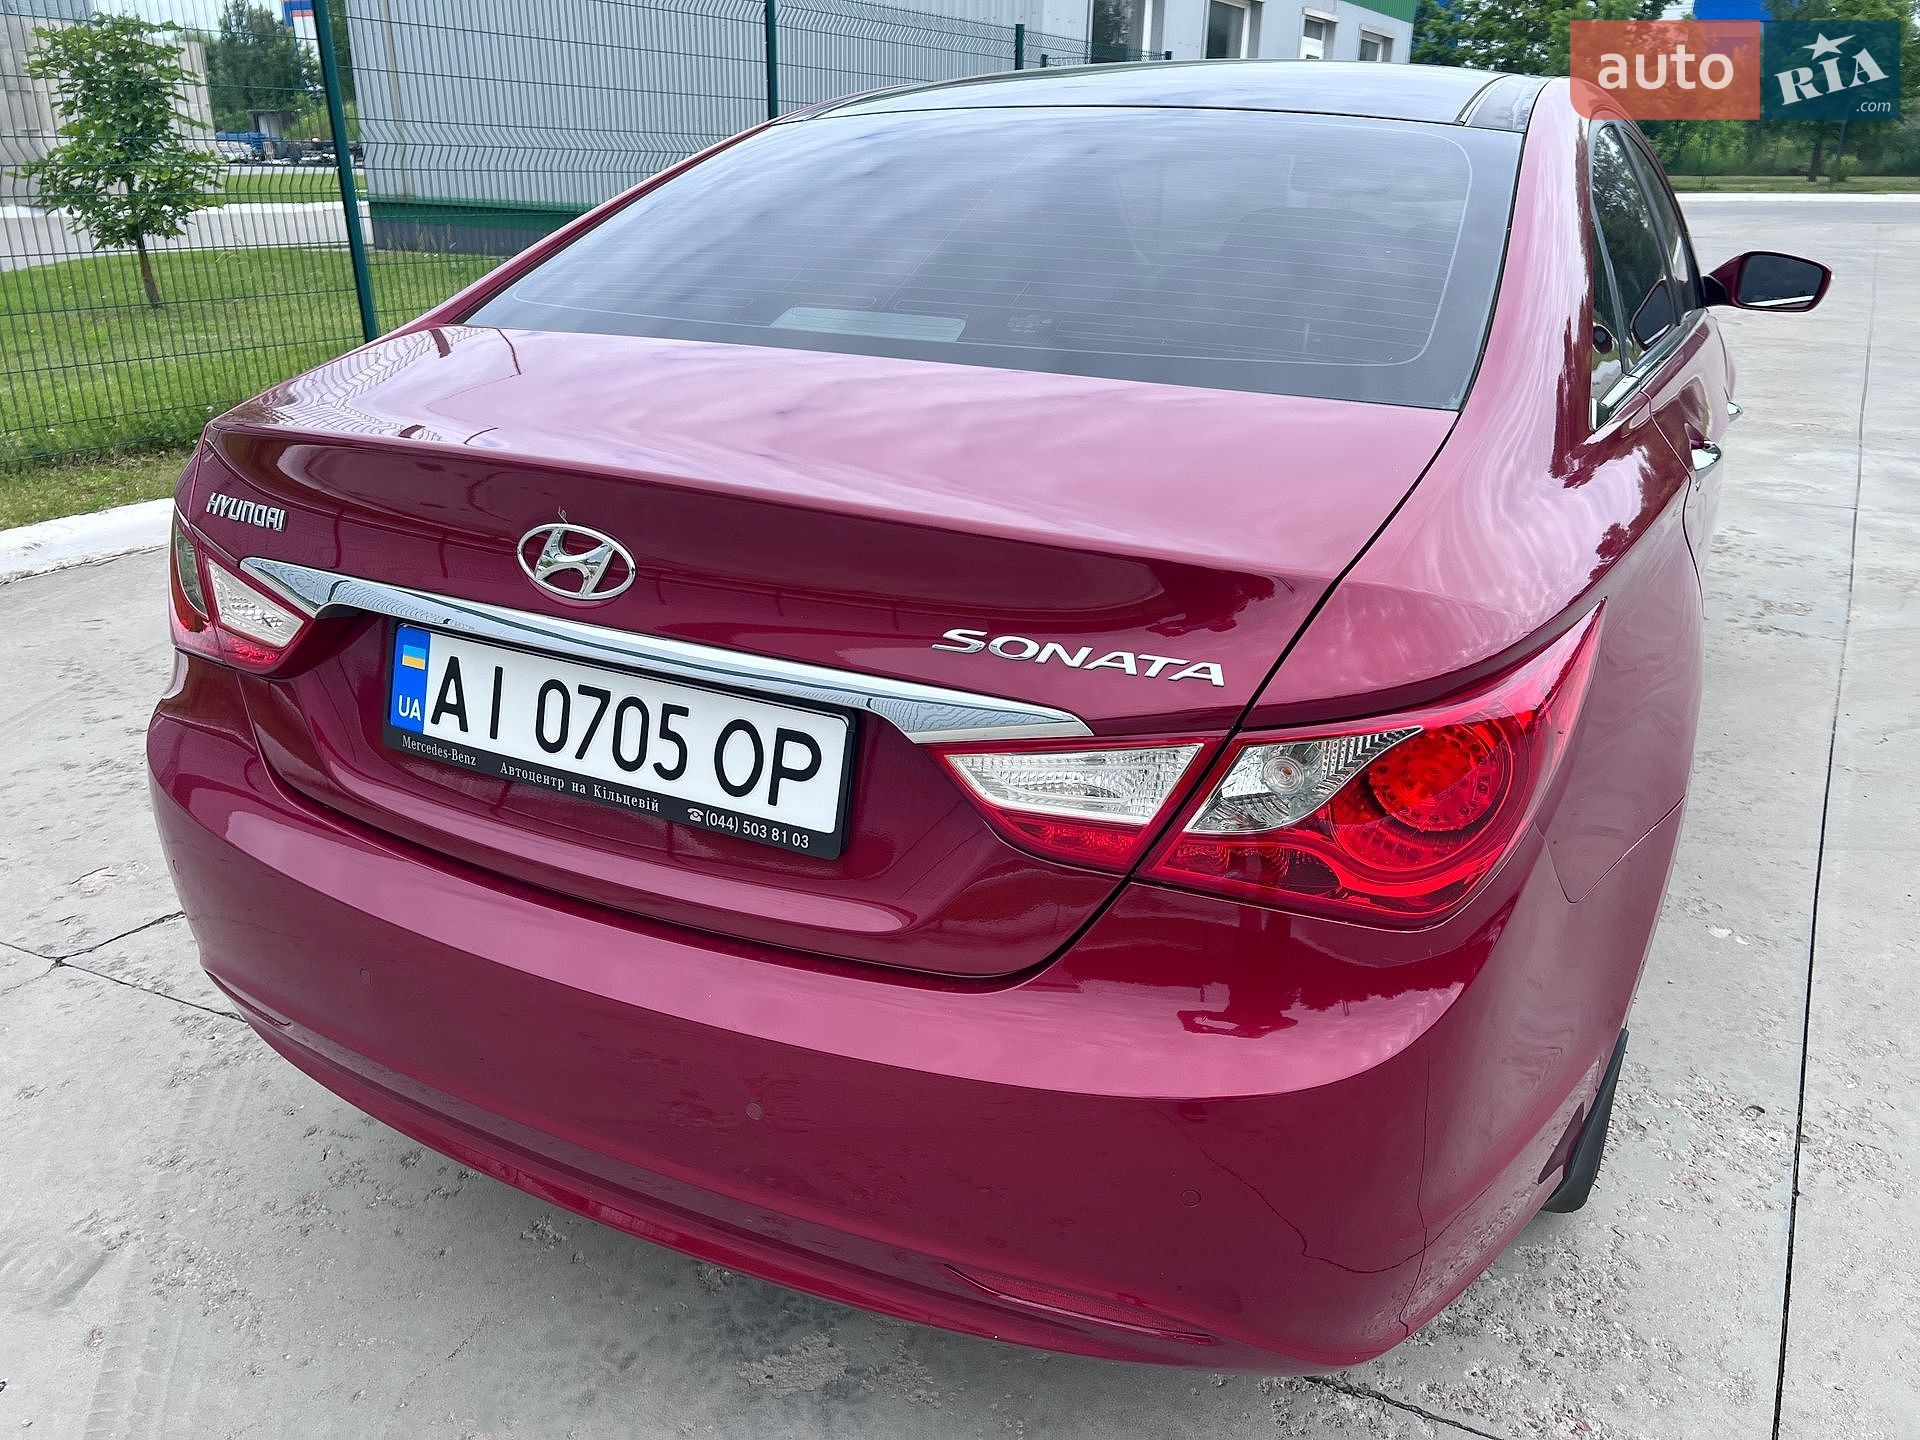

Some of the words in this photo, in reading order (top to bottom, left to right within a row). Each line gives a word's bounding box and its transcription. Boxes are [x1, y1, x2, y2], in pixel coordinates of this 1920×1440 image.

[206, 492, 287, 532] HYUNDAI
[931, 628, 1225, 687] SONATA
[398, 694, 422, 721] UA
[402, 735, 477, 766] Mercedes-Benz
[430, 655, 504, 740] AI
[535, 678, 690, 781] 0705
[714, 718, 822, 806] OP
[500, 762, 565, 791] Автоцентр
[572, 781, 586, 794] на
[594, 784, 660, 812] Кільцевій
[706, 810, 739, 833] (044)
[743, 821, 767, 838] 503
[771, 828, 787, 843] 81
[792, 832, 809, 848] 03
